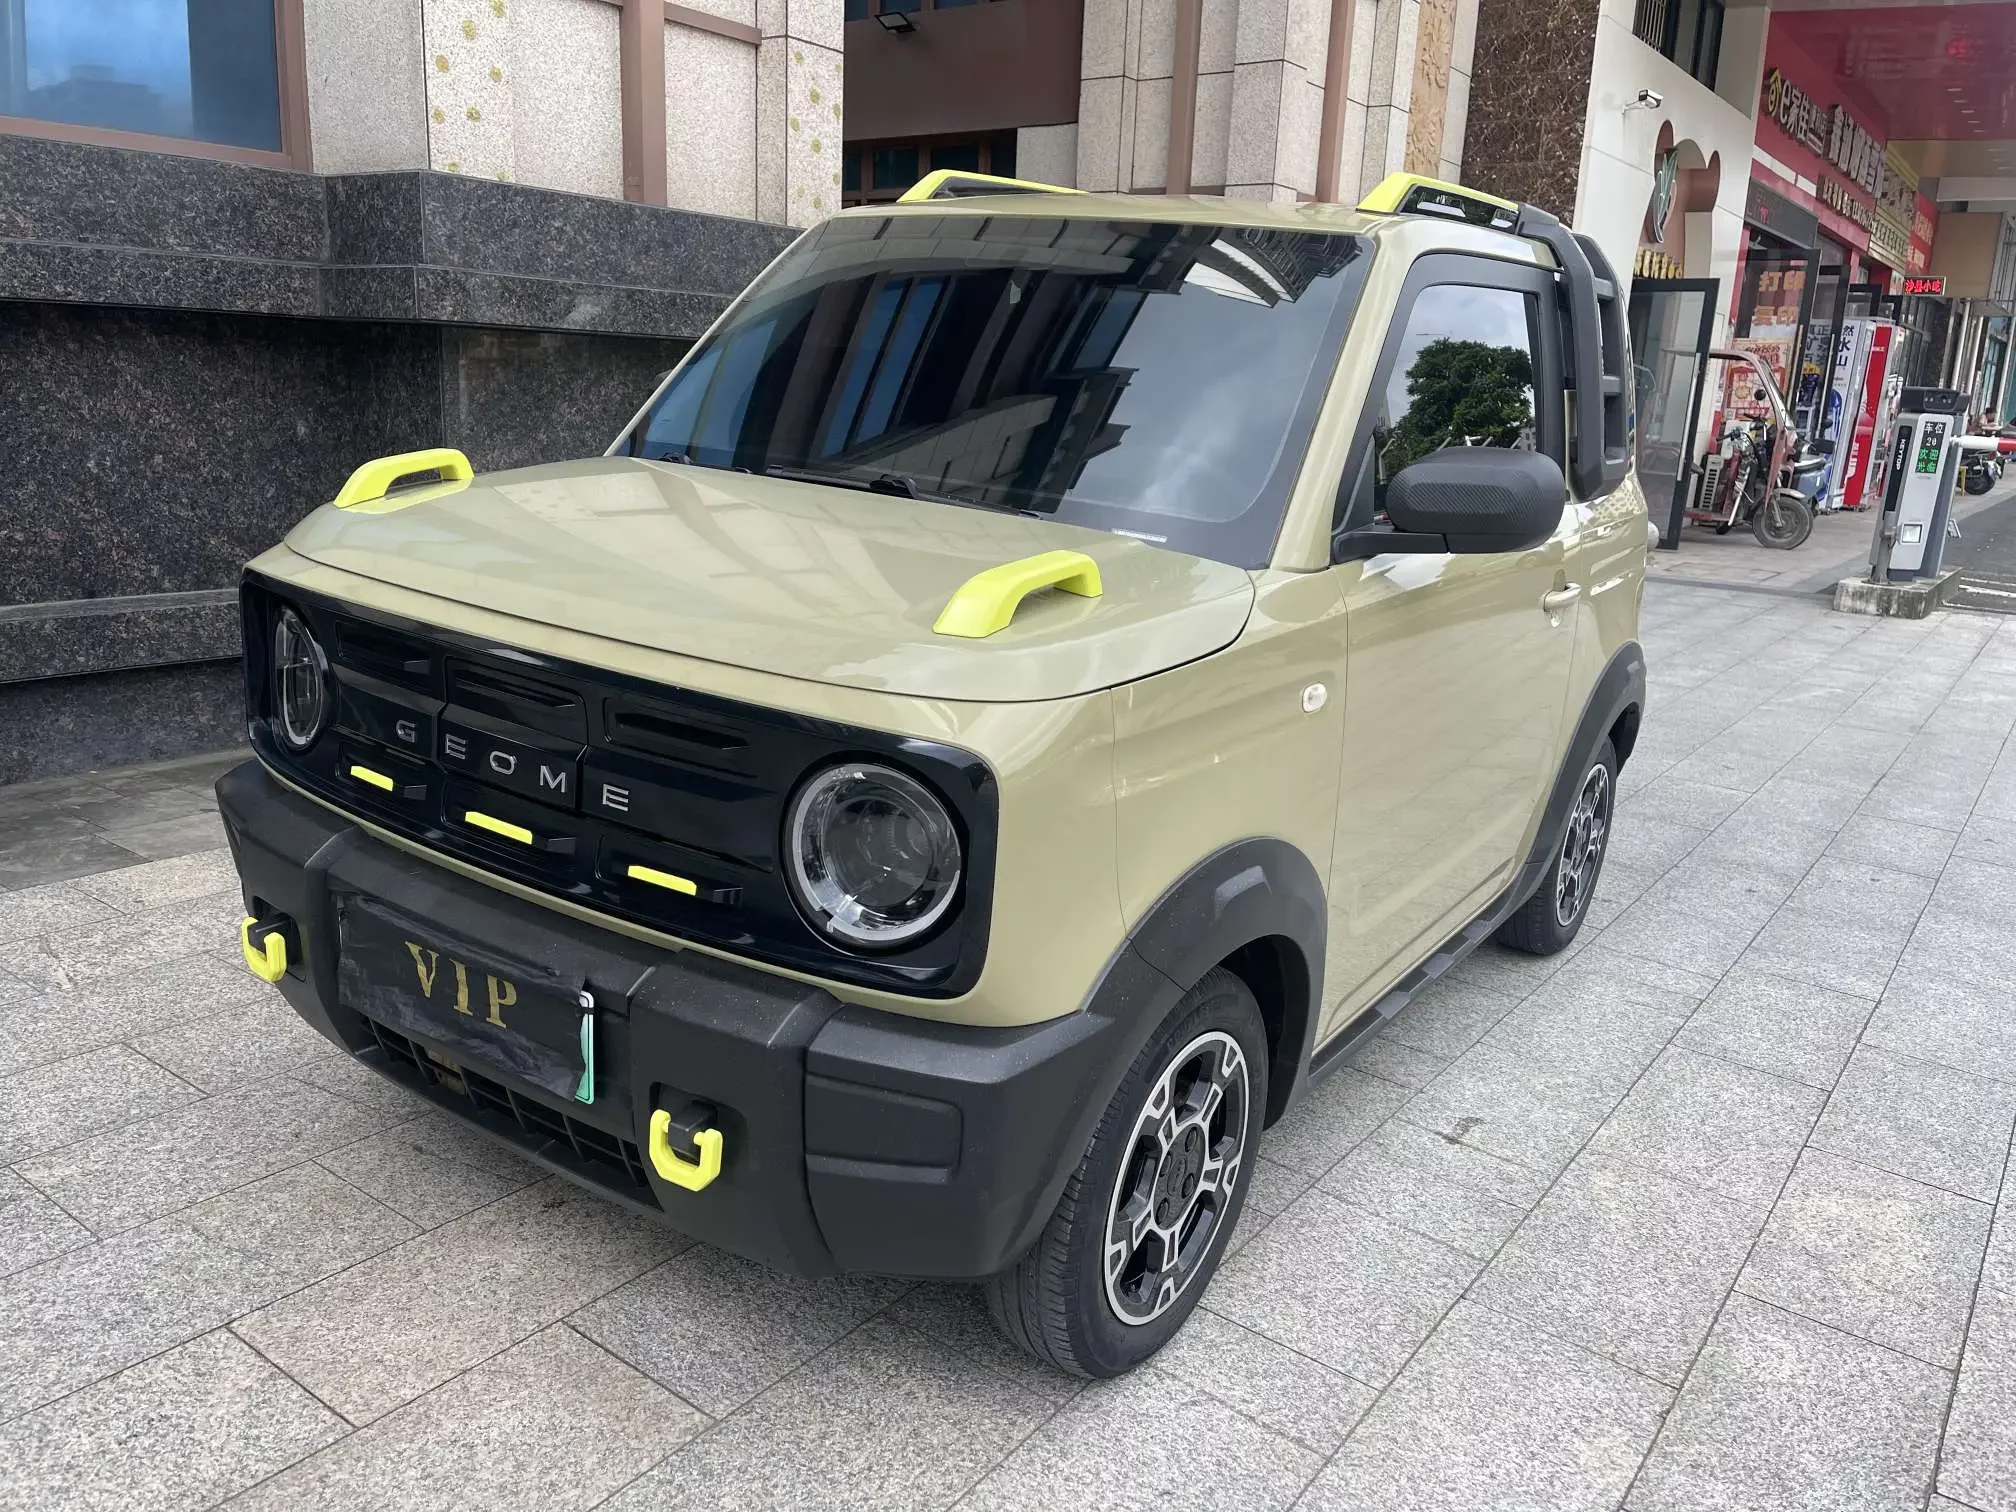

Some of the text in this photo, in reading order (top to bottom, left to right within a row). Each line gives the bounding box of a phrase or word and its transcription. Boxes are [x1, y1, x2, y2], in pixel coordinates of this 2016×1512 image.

[1758, 271, 1807, 292] 打印
[1924, 422, 1944, 434] 车位
[1926, 437, 1937, 447] 20
[1896, 438, 1906, 471] KEYTOP
[1919, 448, 1939, 460] 欢迎
[396, 720, 630, 812] GEOME
[405, 941, 519, 1030] VIP
